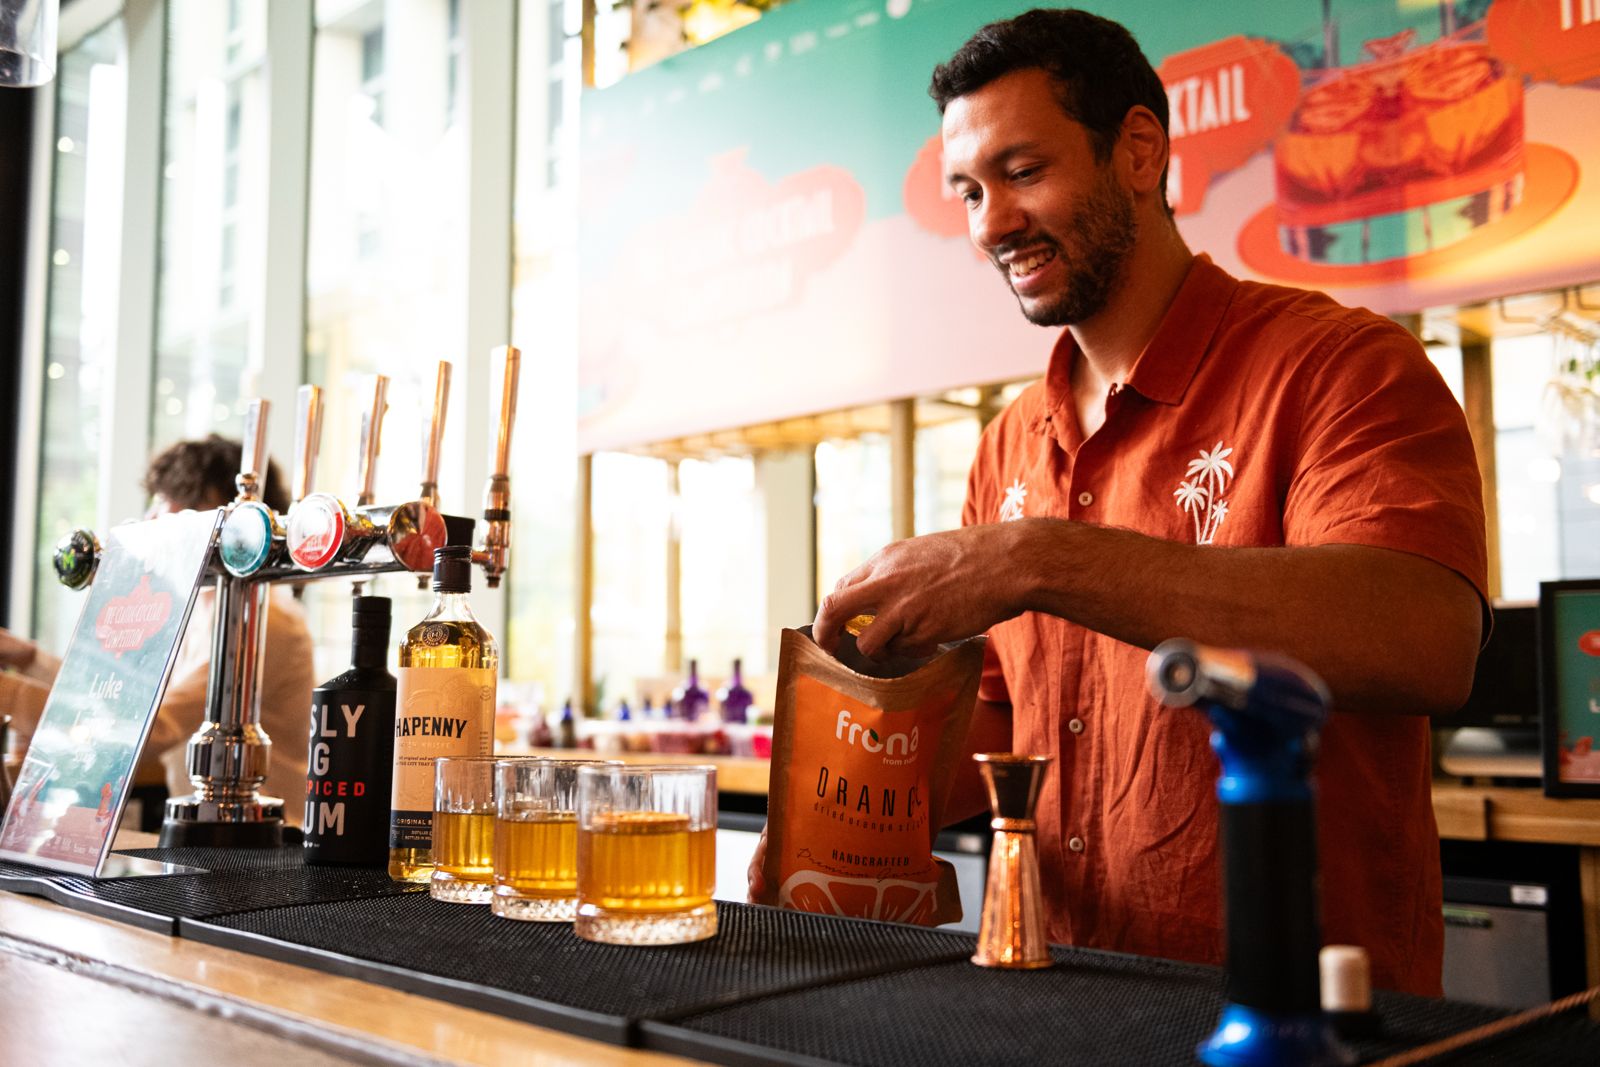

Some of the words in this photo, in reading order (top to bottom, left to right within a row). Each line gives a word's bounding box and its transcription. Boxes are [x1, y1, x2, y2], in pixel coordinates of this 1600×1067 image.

[88, 671, 123, 700] Luke
[310, 704, 366, 738] SLY
[883, 757, 903, 766] from
[306, 780, 366, 797] PICED
[305, 801, 345, 836] UM
[814, 802, 845, 822] dried
[849, 817, 893, 833] orange
[832, 849, 910, 867] HANDCRAFTED
